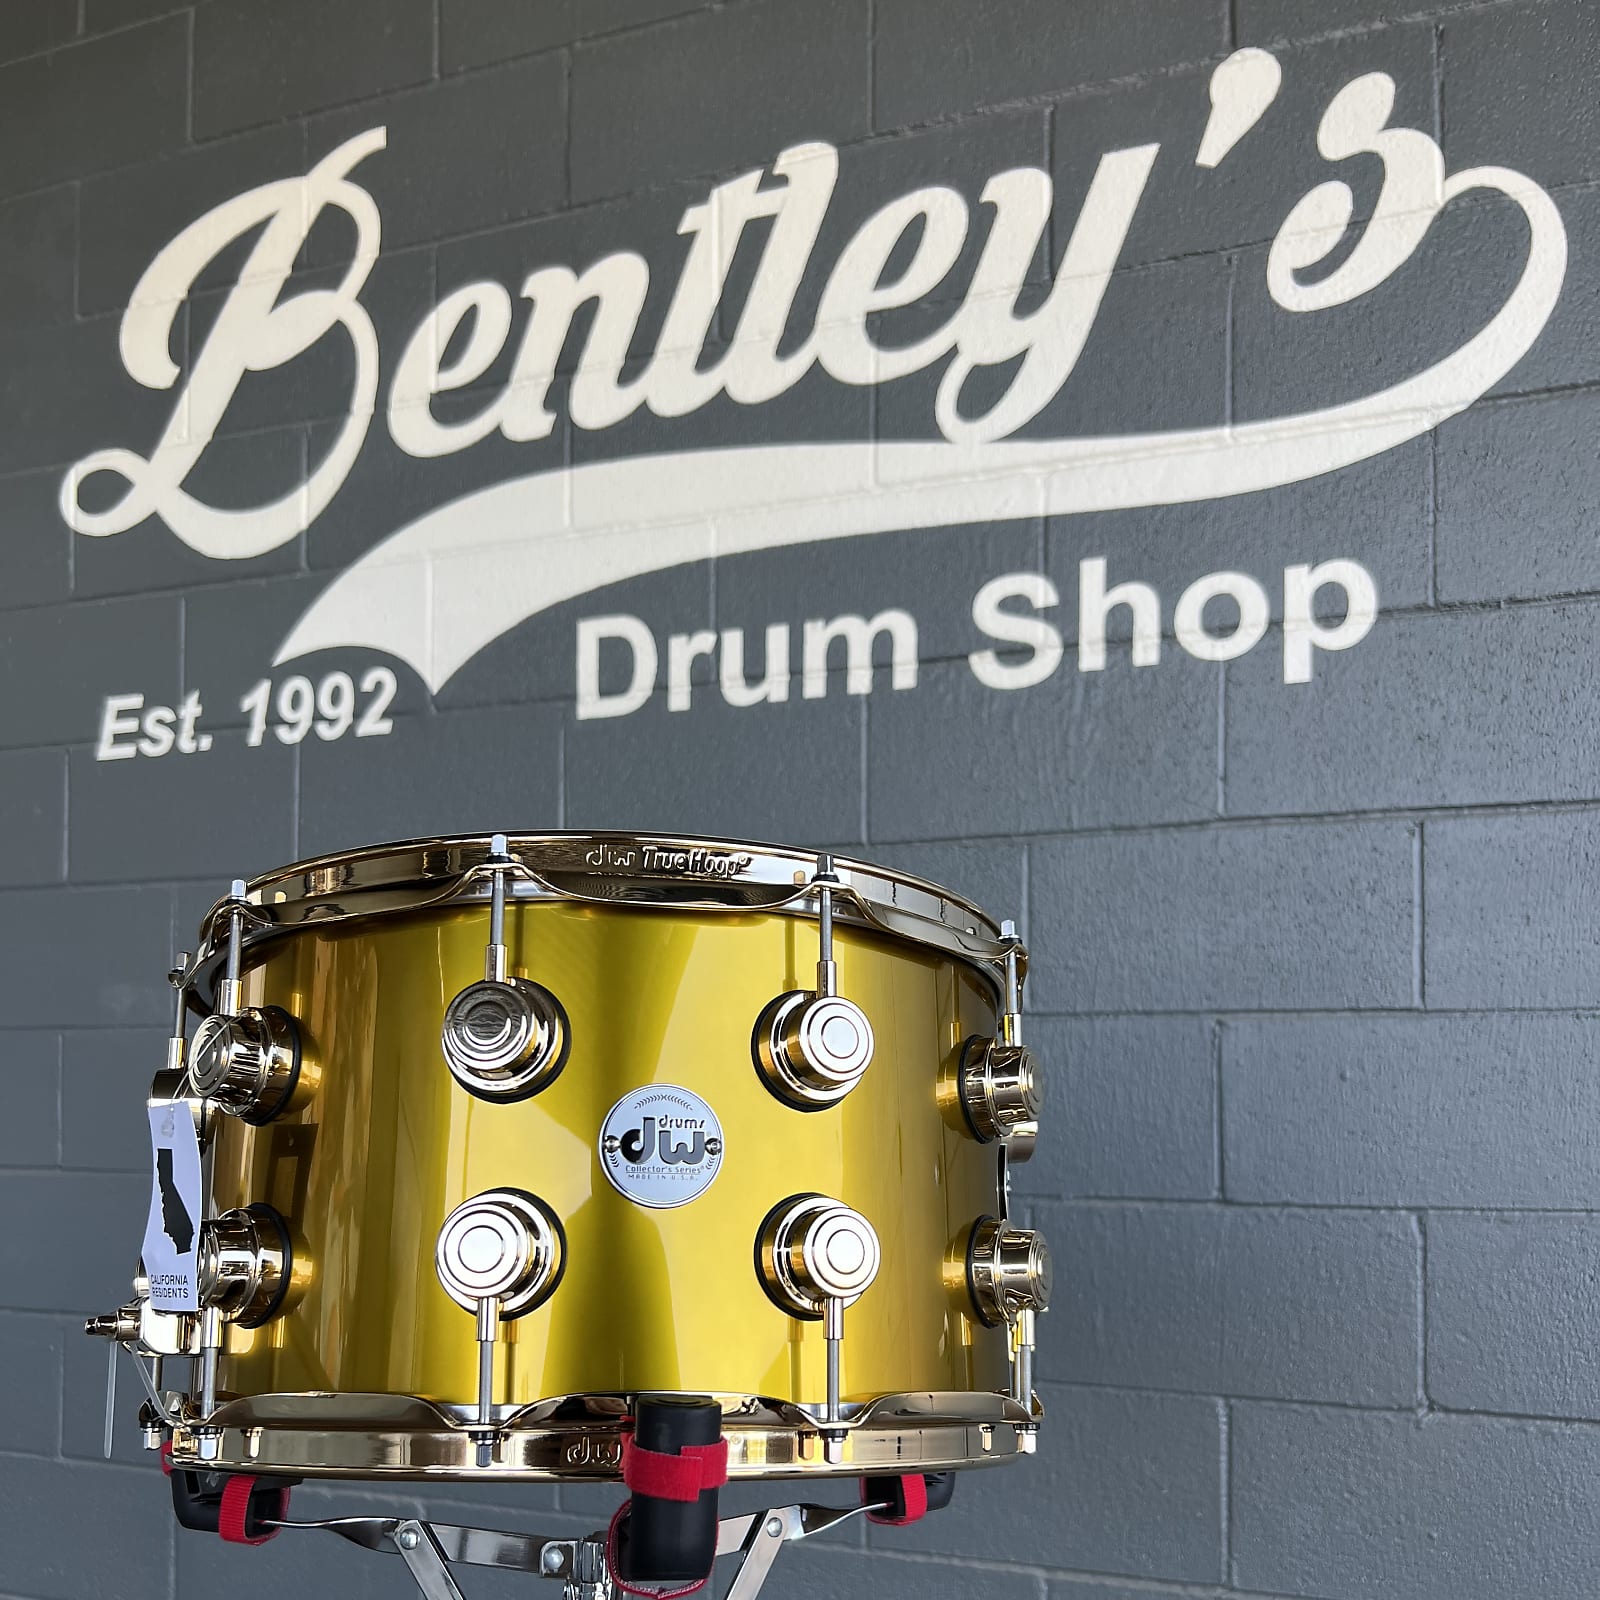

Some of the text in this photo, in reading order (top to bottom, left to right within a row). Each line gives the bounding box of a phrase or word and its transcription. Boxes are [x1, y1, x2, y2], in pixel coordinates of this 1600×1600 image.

[59, 46, 1452, 561] Bentley's
[574, 557, 1380, 721] Drum Shop
[95, 666, 398, 762] Est. 1992
[620, 1116, 705, 1165] dw
[658, 1114, 705, 1129] drums
[150, 1274, 189, 1286] CALIFORNIA
[151, 1286, 189, 1299] RESIDENTS
